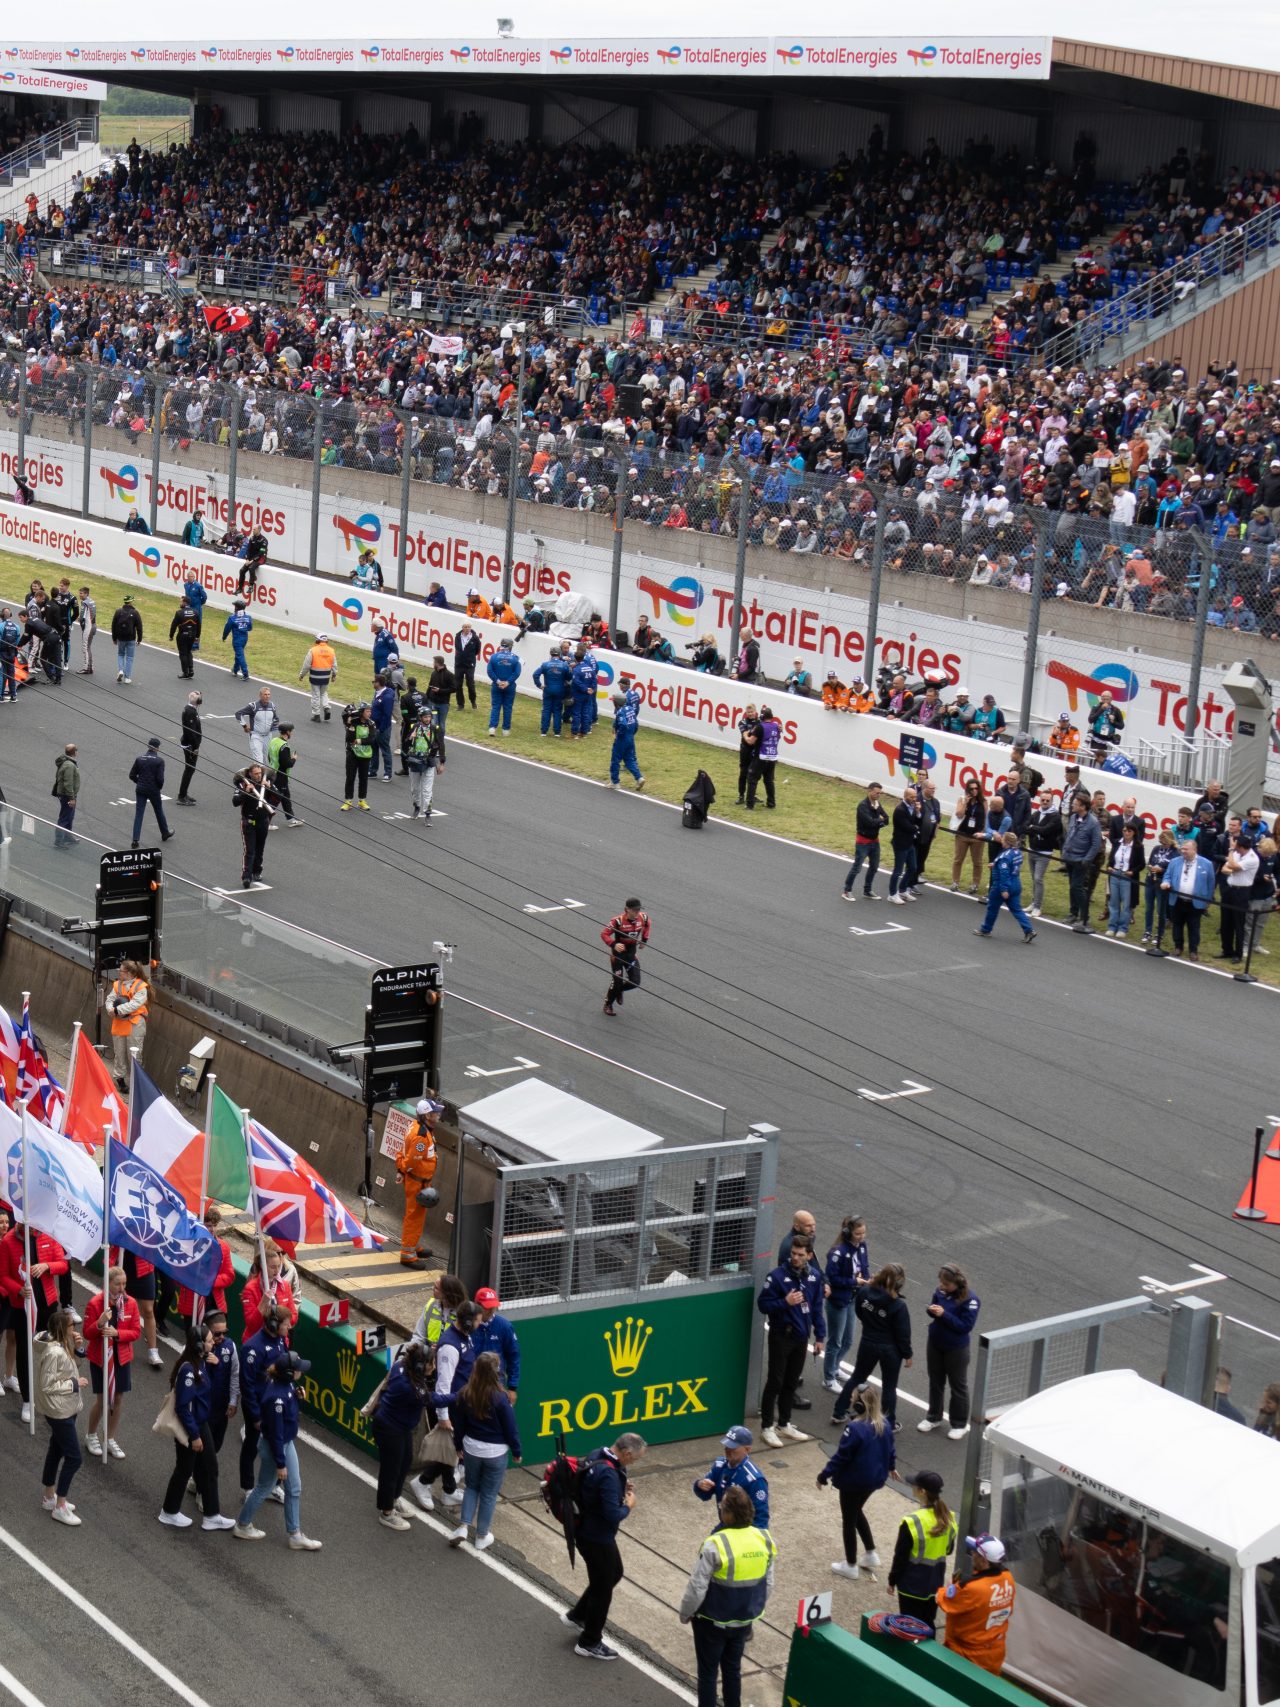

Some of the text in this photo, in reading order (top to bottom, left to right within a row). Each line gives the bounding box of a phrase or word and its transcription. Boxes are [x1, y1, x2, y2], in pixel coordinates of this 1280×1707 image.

[18, 48, 62, 62] TotalEnergies
[80, 48, 127, 63] TotalEnergies
[146, 48, 196, 64] TotalEnergies
[218, 48, 272, 64] TotalEnergies
[296, 48, 354, 64] TotalEnergies
[380, 47, 444, 64] TotalEnergies
[472, 47, 542, 66] TotalEnergies
[574, 47, 650, 66] TotalEnergies
[683, 48, 767, 66] TotalEnergies
[806, 47, 898, 67] TotalEnergies
[940, 48, 1043, 70] TotalEnergies
[16, 74, 89, 92] TotalEnergies
[108, 864, 139, 872] ENDURANCE
[380, 983, 414, 992] ENDURANCE
[326, 1302, 341, 1322] 4
[364, 1329, 378, 1350] 5
[304, 1376, 376, 1446] ROLE
[537, 1377, 708, 1437] ROLEX
[1072, 1470, 1124, 1502] MANTHEY
[806, 1596, 821, 1623] 6
